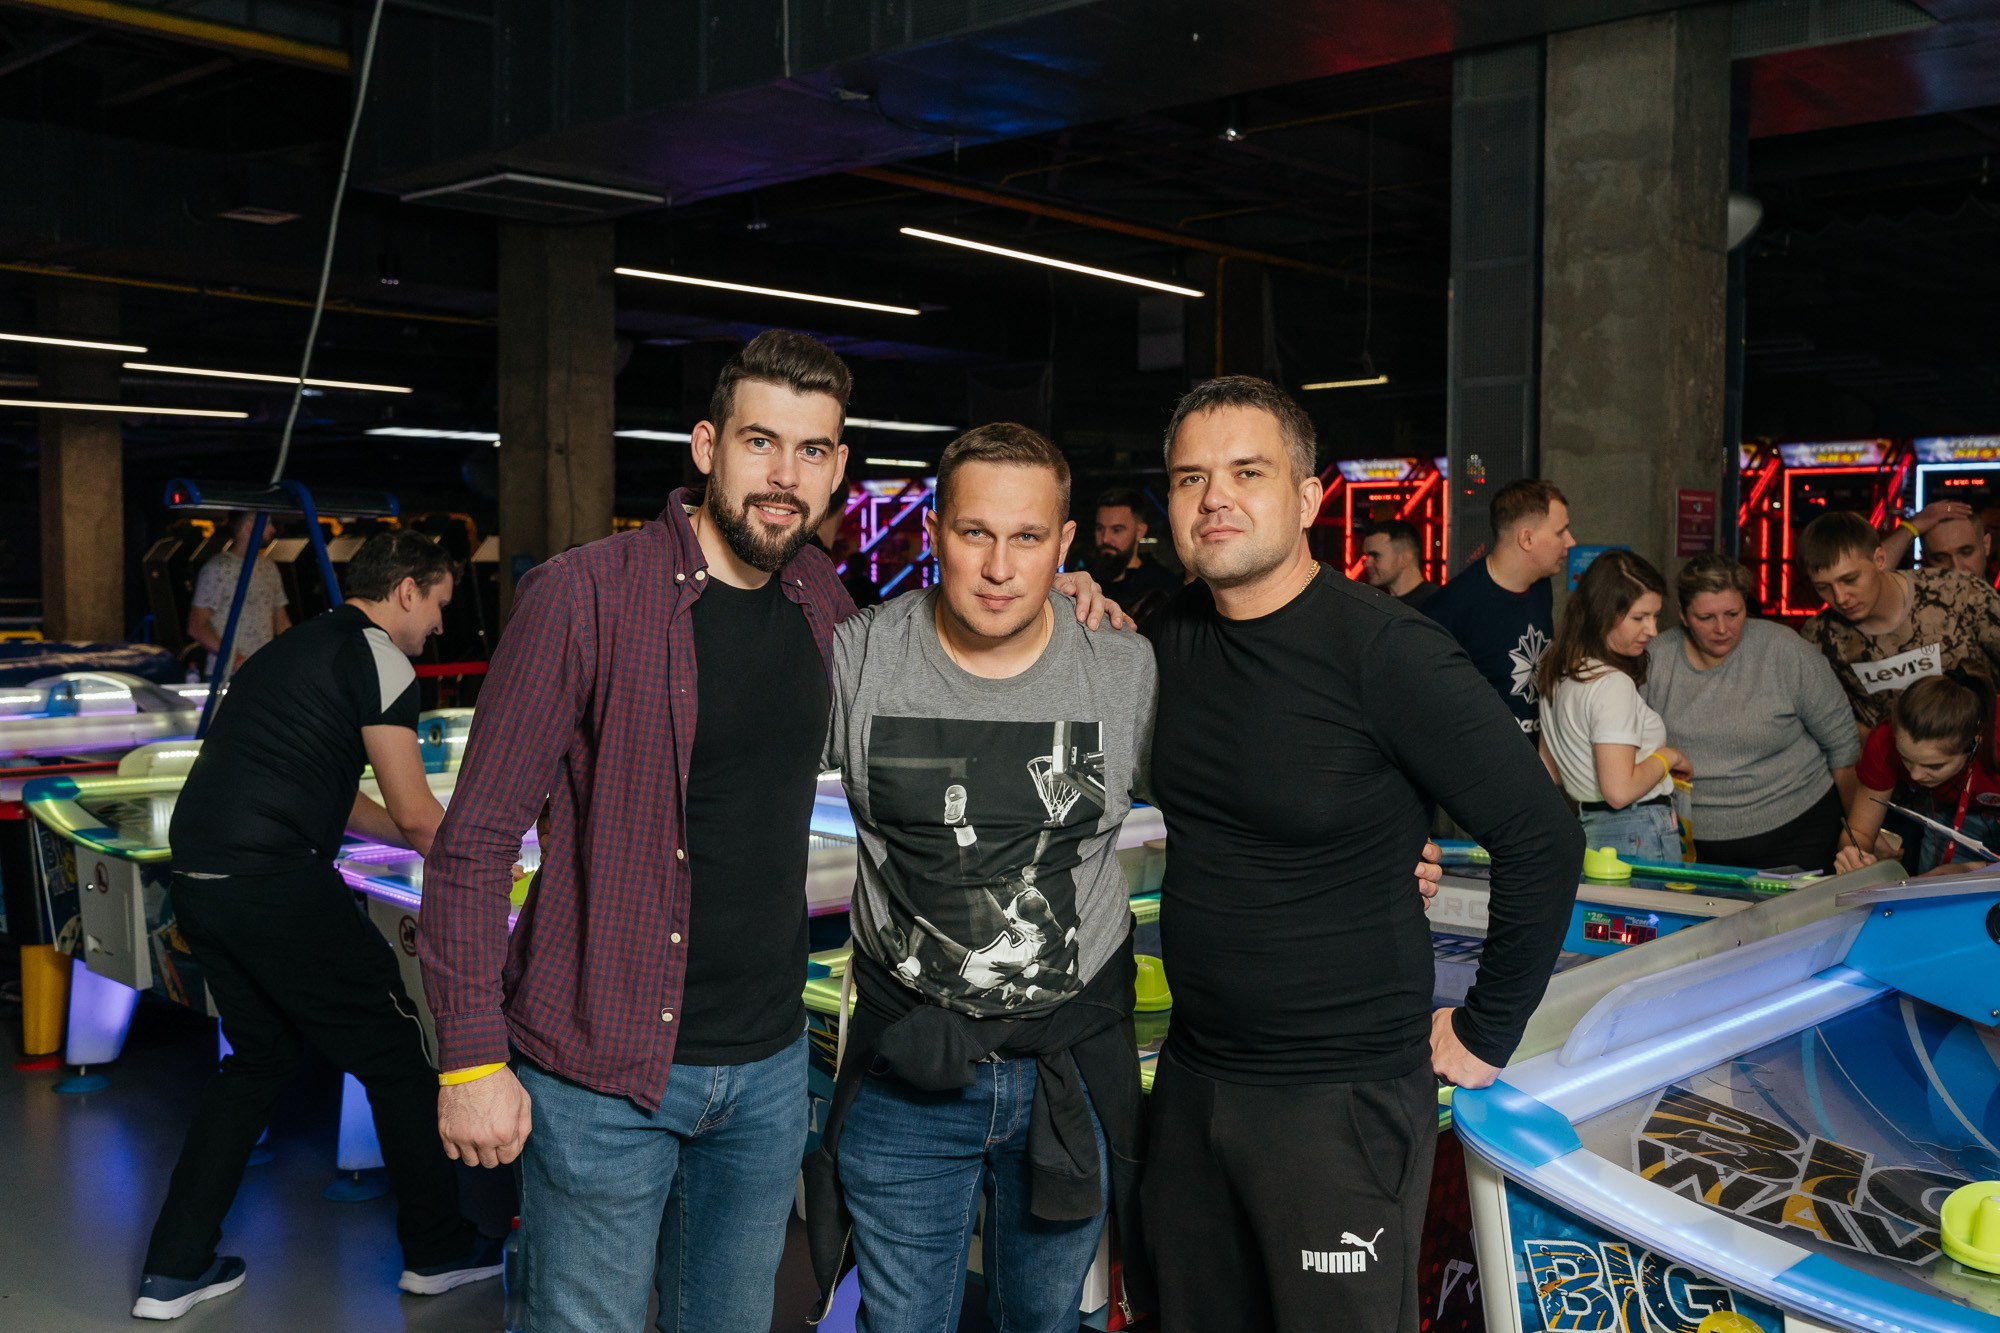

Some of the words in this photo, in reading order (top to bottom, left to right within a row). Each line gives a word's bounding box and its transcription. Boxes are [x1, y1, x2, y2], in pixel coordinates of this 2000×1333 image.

[1631, 1134, 1998, 1283] WAV
[1301, 1249, 1366, 1273] PUMA
[1523, 1239, 1739, 1333] BIG
